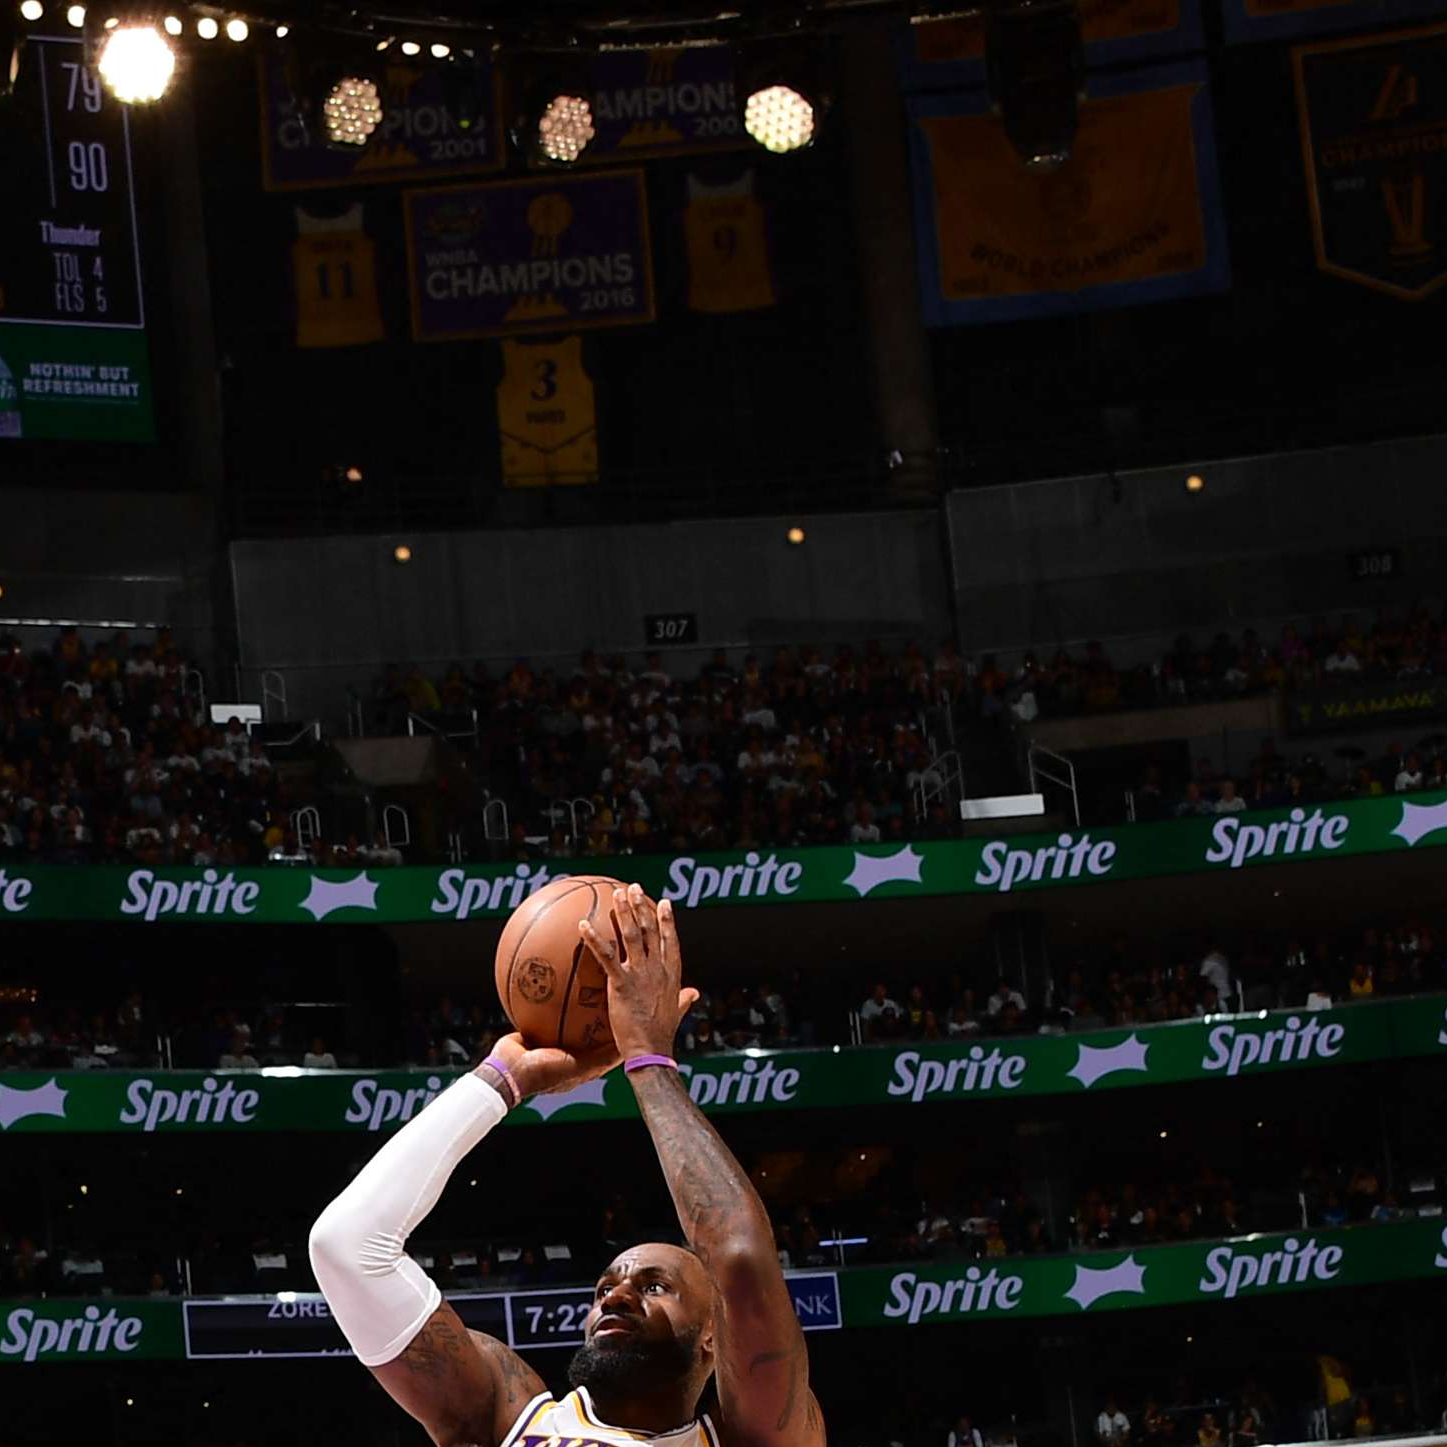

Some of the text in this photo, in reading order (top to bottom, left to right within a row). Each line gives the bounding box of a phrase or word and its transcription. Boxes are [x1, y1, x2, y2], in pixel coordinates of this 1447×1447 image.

[68, 141, 110, 193] 90
[430, 138, 488, 161] 2001
[39, 220, 102, 247] Thunder
[425, 249, 479, 268] WNBA
[969, 241, 1043, 280] WORLD
[1050, 221, 1171, 279] CHAMPIONS
[53, 252, 104, 282] TOL 4
[312, 262, 356, 300] 11
[425, 252, 635, 300] CHAMPIONS
[54, 283, 85, 313] FLS
[579, 287, 636, 312] 2016
[22, 378, 140, 398] REFRESHMENT
[28, 362, 130, 381] NOTHIN' BUT
[530, 358, 559, 402] 3
[654, 620, 688, 639] 307
[976, 834, 1115, 891] Sprite
[1207, 808, 1348, 867] Sprite
[121, 869, 258, 920] Sprite
[433, 864, 571, 919] Sprit
[663, 853, 801, 907] Sprite
[1203, 1016, 1344, 1075] Sprite
[888, 1047, 1025, 1101] Sprite
[121, 1077, 258, 1131] Sprite
[1200, 1238, 1342, 1297] Sprite
[884, 1267, 1022, 1323] Sprite
[0, 1306, 141, 1361] Sprite
